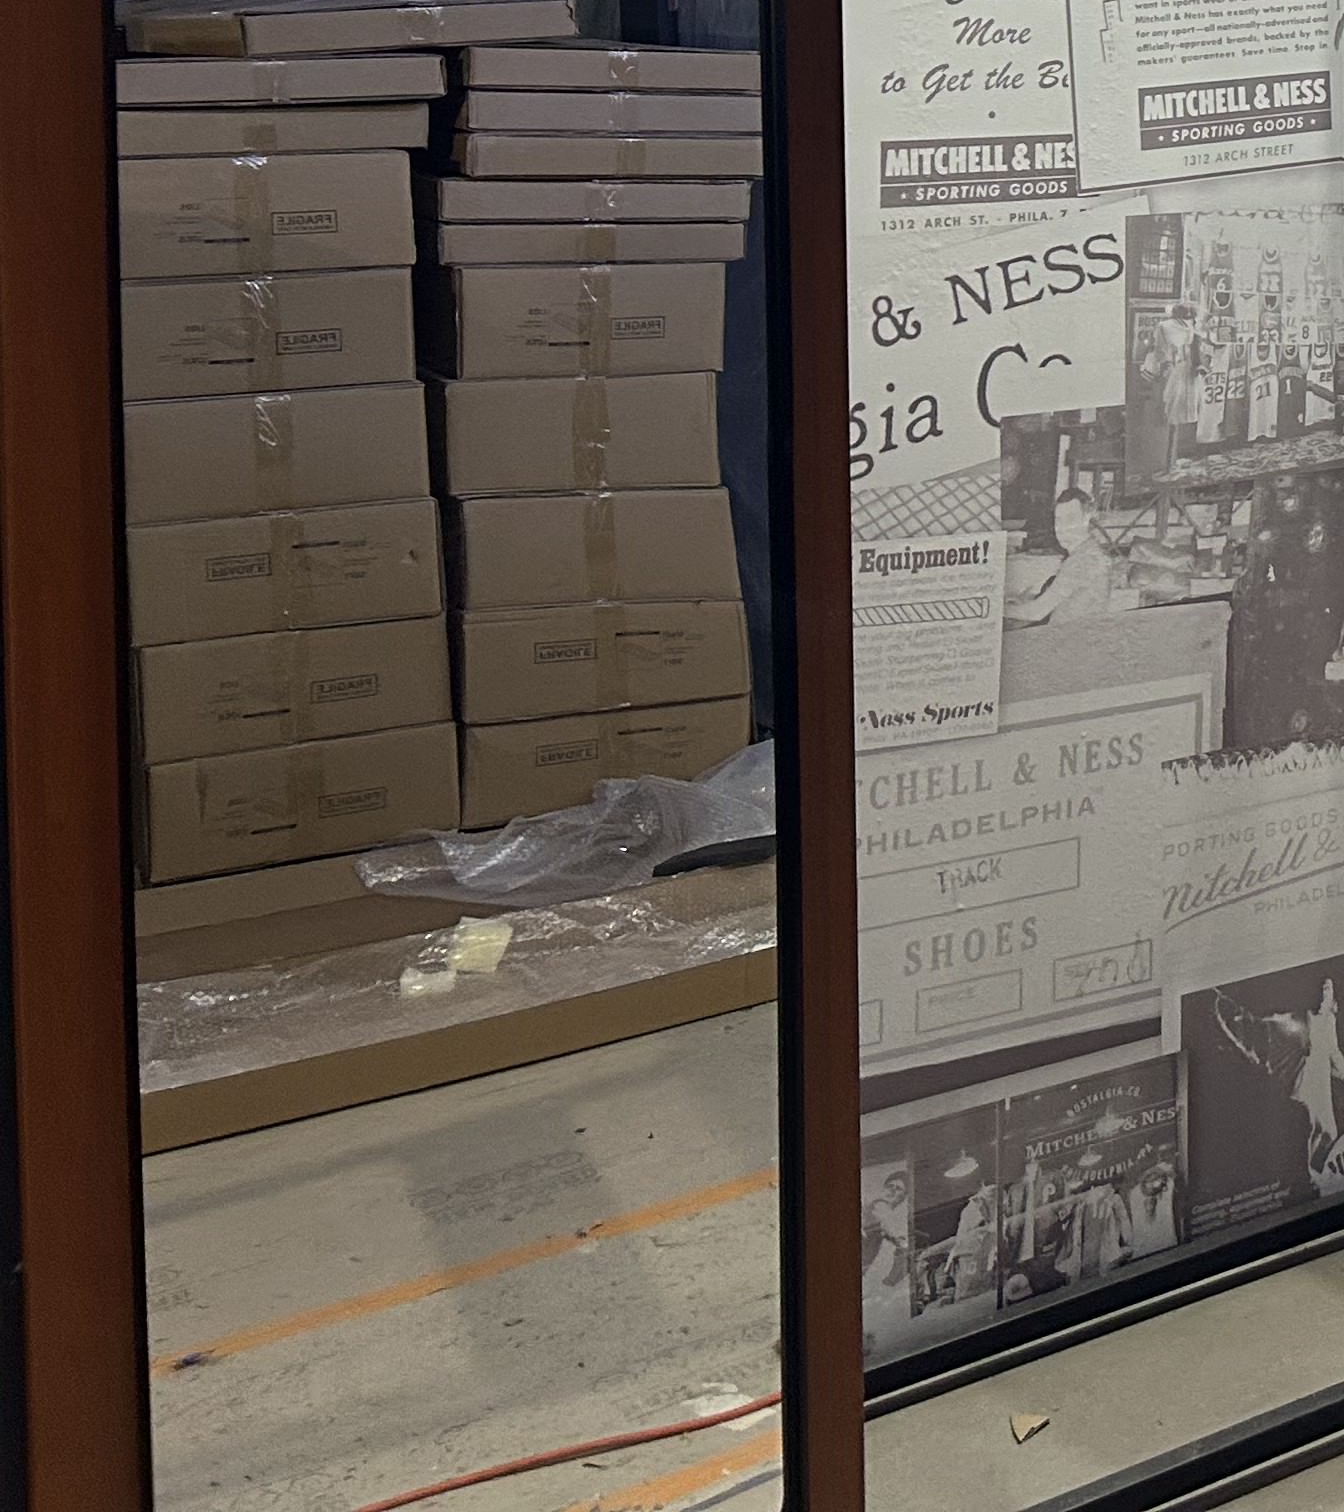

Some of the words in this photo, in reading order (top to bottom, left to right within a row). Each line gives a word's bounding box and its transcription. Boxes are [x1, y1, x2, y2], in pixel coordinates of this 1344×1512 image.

[951, 16, 1032, 47] More
[880, 70, 907, 95] to
[922, 63, 976, 104] Get
[984, 61, 1025, 90] the
[1143, 86, 1251, 122] MITCHELL
[1253, 83, 1272, 110] &
[1272, 77, 1328, 108] NESS
[1171, 123, 1246, 143] SPORTING
[1253, 116, 1305, 134] GOODS
[1183, 153, 1211, 168] 1312
[1215, 149, 1249, 164] ARCH
[1253, 144, 1294, 159] STREET
[915, 184, 1001, 201] SPORTING
[1009, 181, 1068, 196] GOODS
[880, 220, 916, 231] 1312
[924, 216, 961, 228] ARCH
[969, 215, 990, 226] ST.
[1009, 211, 1054, 223] PHILA.
[871, 294, 922, 347] &
[944, 232, 1125, 326] NESS
[858, 539, 991, 577] Equipment!
[856, 758, 993, 811] CHELL
[1012, 751, 1038, 787] &
[1058, 732, 1145, 778] NESS
[935, 856, 1003, 895] TRACK
[903, 916, 1039, 977] SHOES
